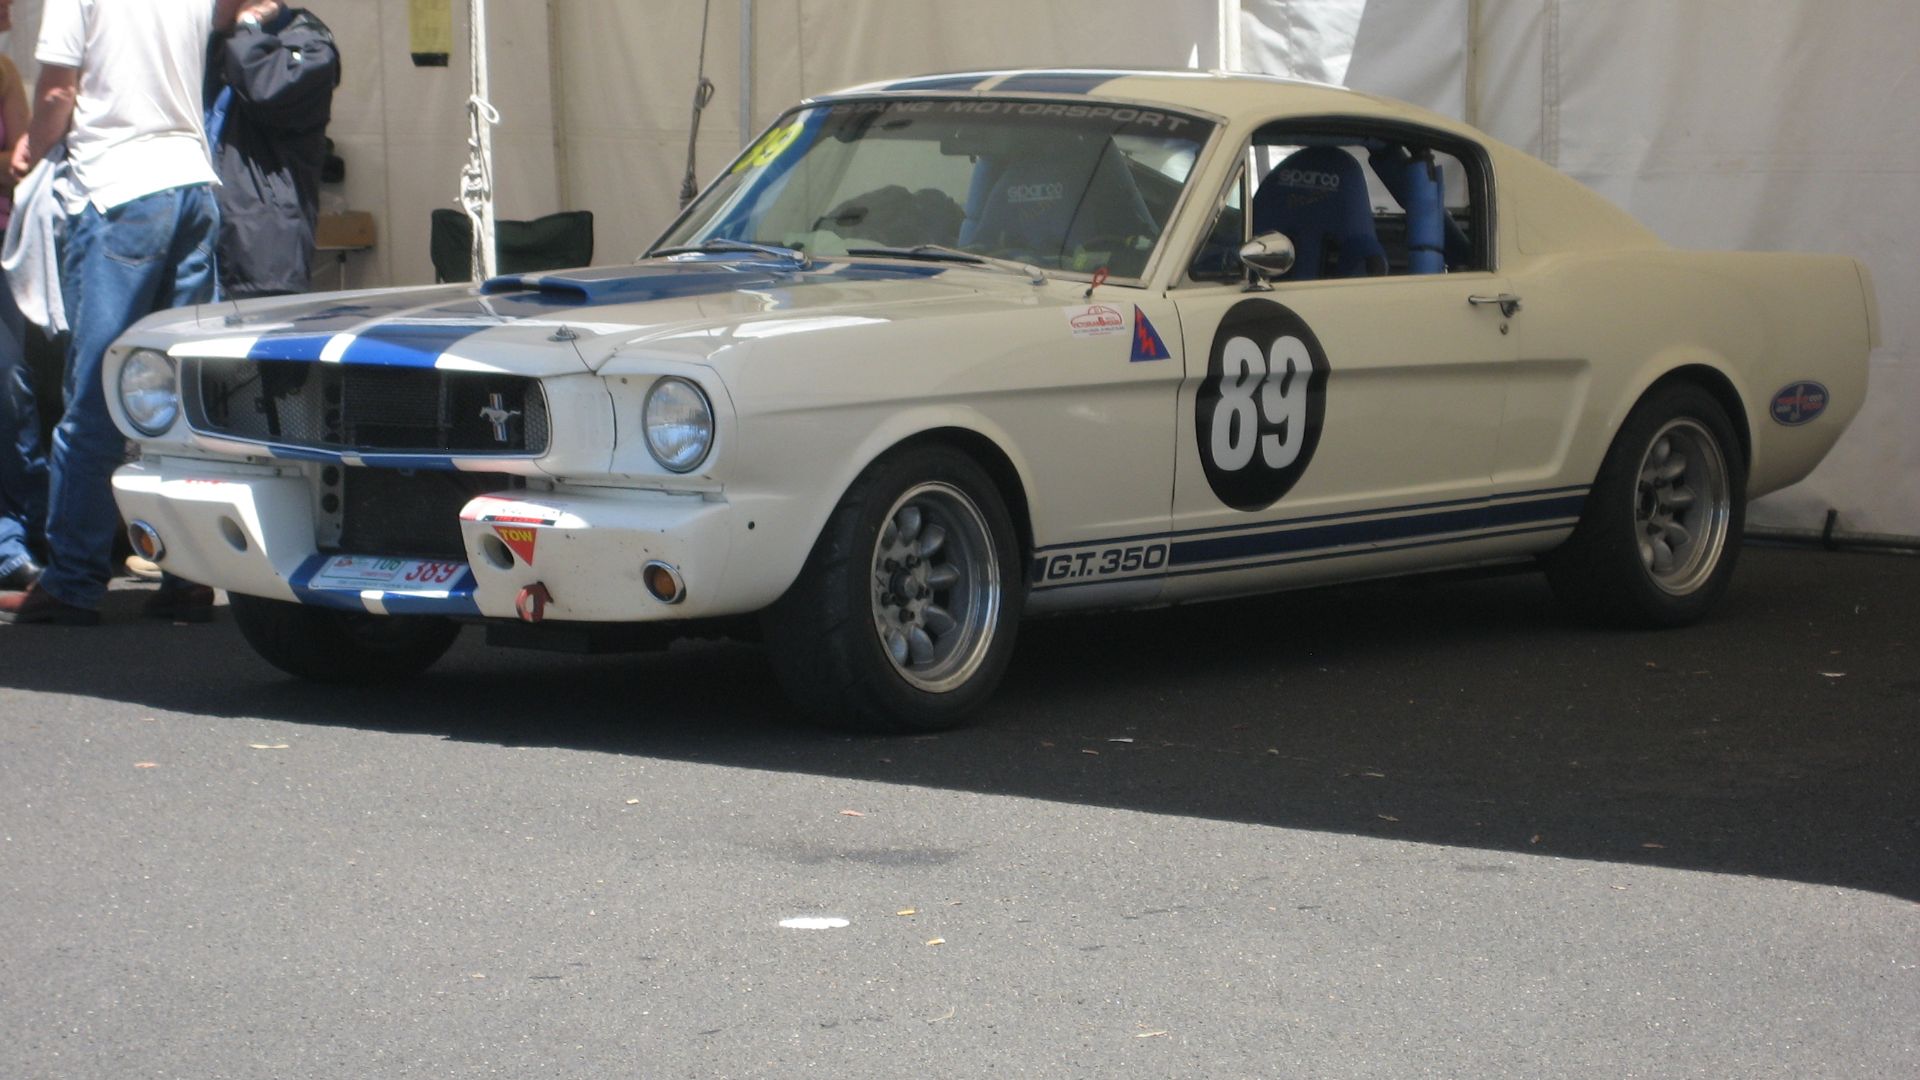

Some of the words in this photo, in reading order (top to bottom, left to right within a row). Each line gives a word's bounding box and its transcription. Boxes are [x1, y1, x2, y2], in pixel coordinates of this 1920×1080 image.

[945, 101, 1190, 131] MOTORSPORT
[1279, 168, 1340, 189] sparco
[1211, 336, 1313, 471] 89
[499, 528, 533, 542] TOW
[405, 560, 460, 583] 389
